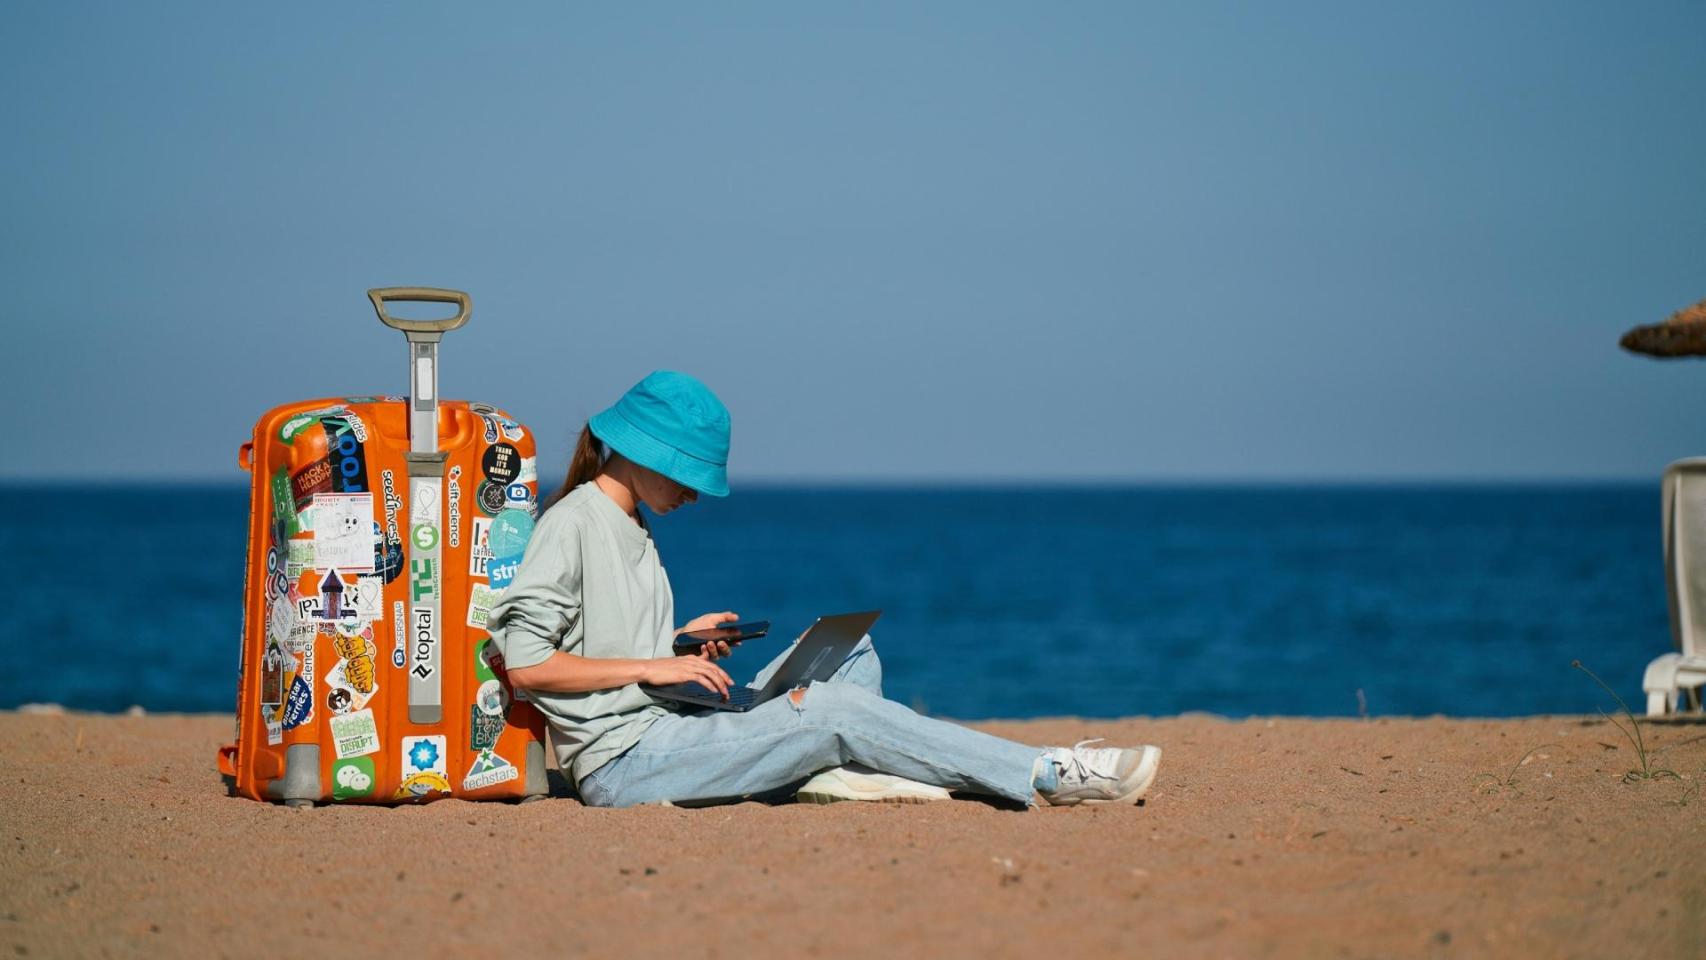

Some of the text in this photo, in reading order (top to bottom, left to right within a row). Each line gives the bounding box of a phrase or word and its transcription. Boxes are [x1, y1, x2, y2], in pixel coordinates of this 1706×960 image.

[495, 446, 513, 455] THANK
[489, 466, 512, 476] MONDAY
[383, 471, 402, 545] seedinvest
[450, 482, 460, 546] sift science
[492, 561, 522, 581] stri
[414, 609, 434, 661] toptal
[283, 681, 302, 726] Blue Star
[288, 689, 309, 726] Ferries
[340, 736, 373, 754] DISRUPT
[464, 768, 518, 790] techstars
